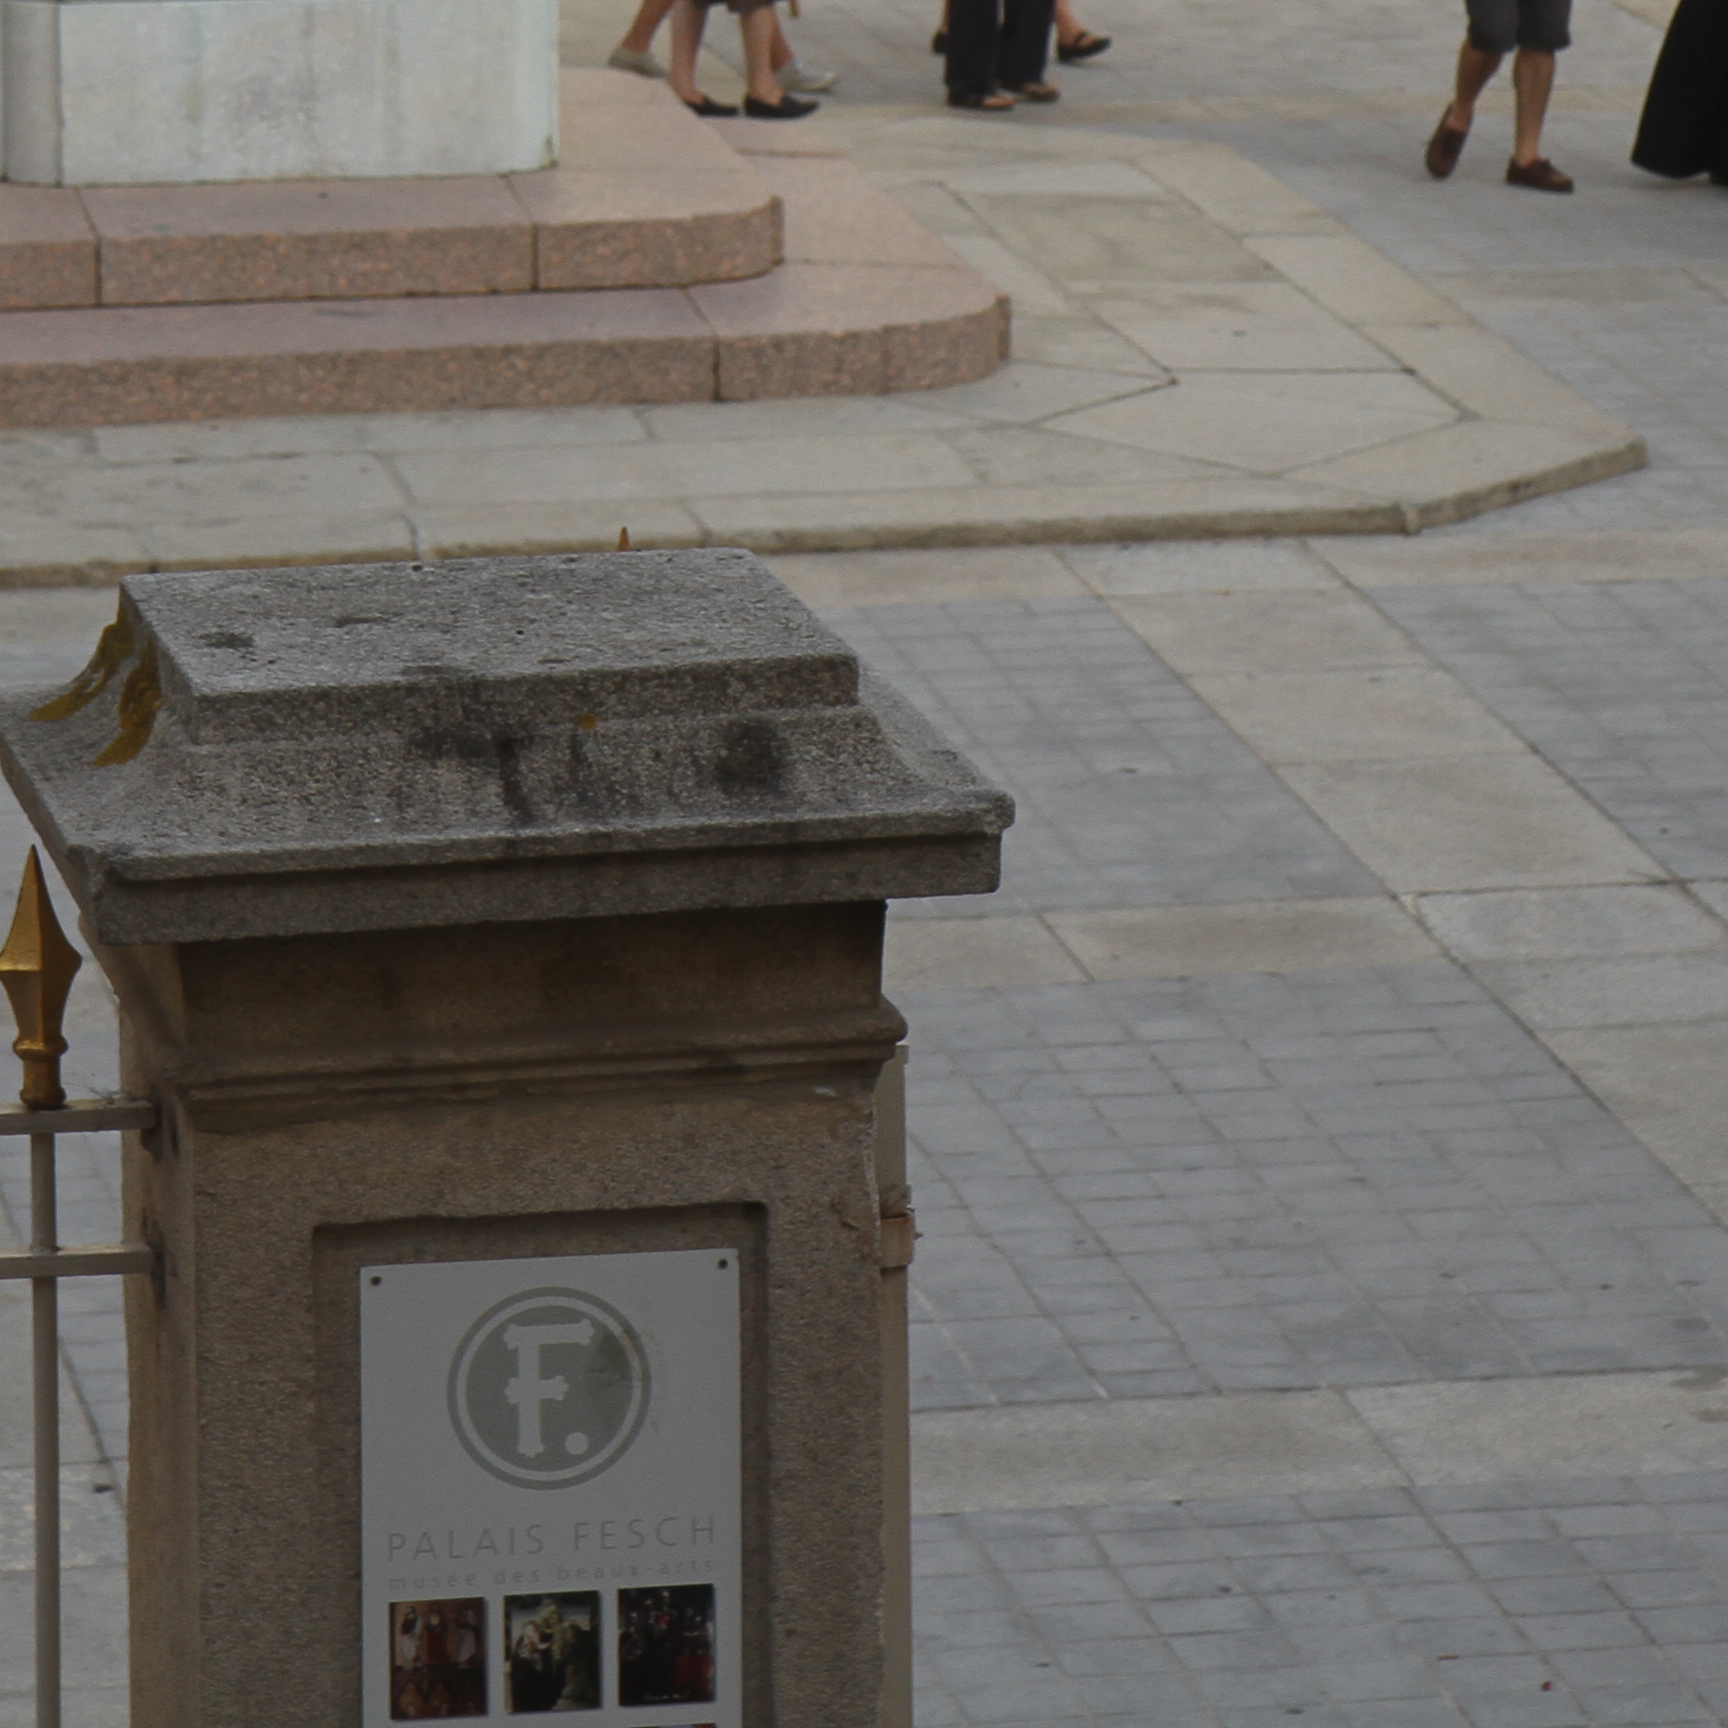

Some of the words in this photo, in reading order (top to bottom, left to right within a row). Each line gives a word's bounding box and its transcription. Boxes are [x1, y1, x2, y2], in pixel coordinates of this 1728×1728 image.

[387, 1524, 544, 1562] PALAIS
[573, 1515, 715, 1552] FESCH
[494, 1567, 540, 1585] des
